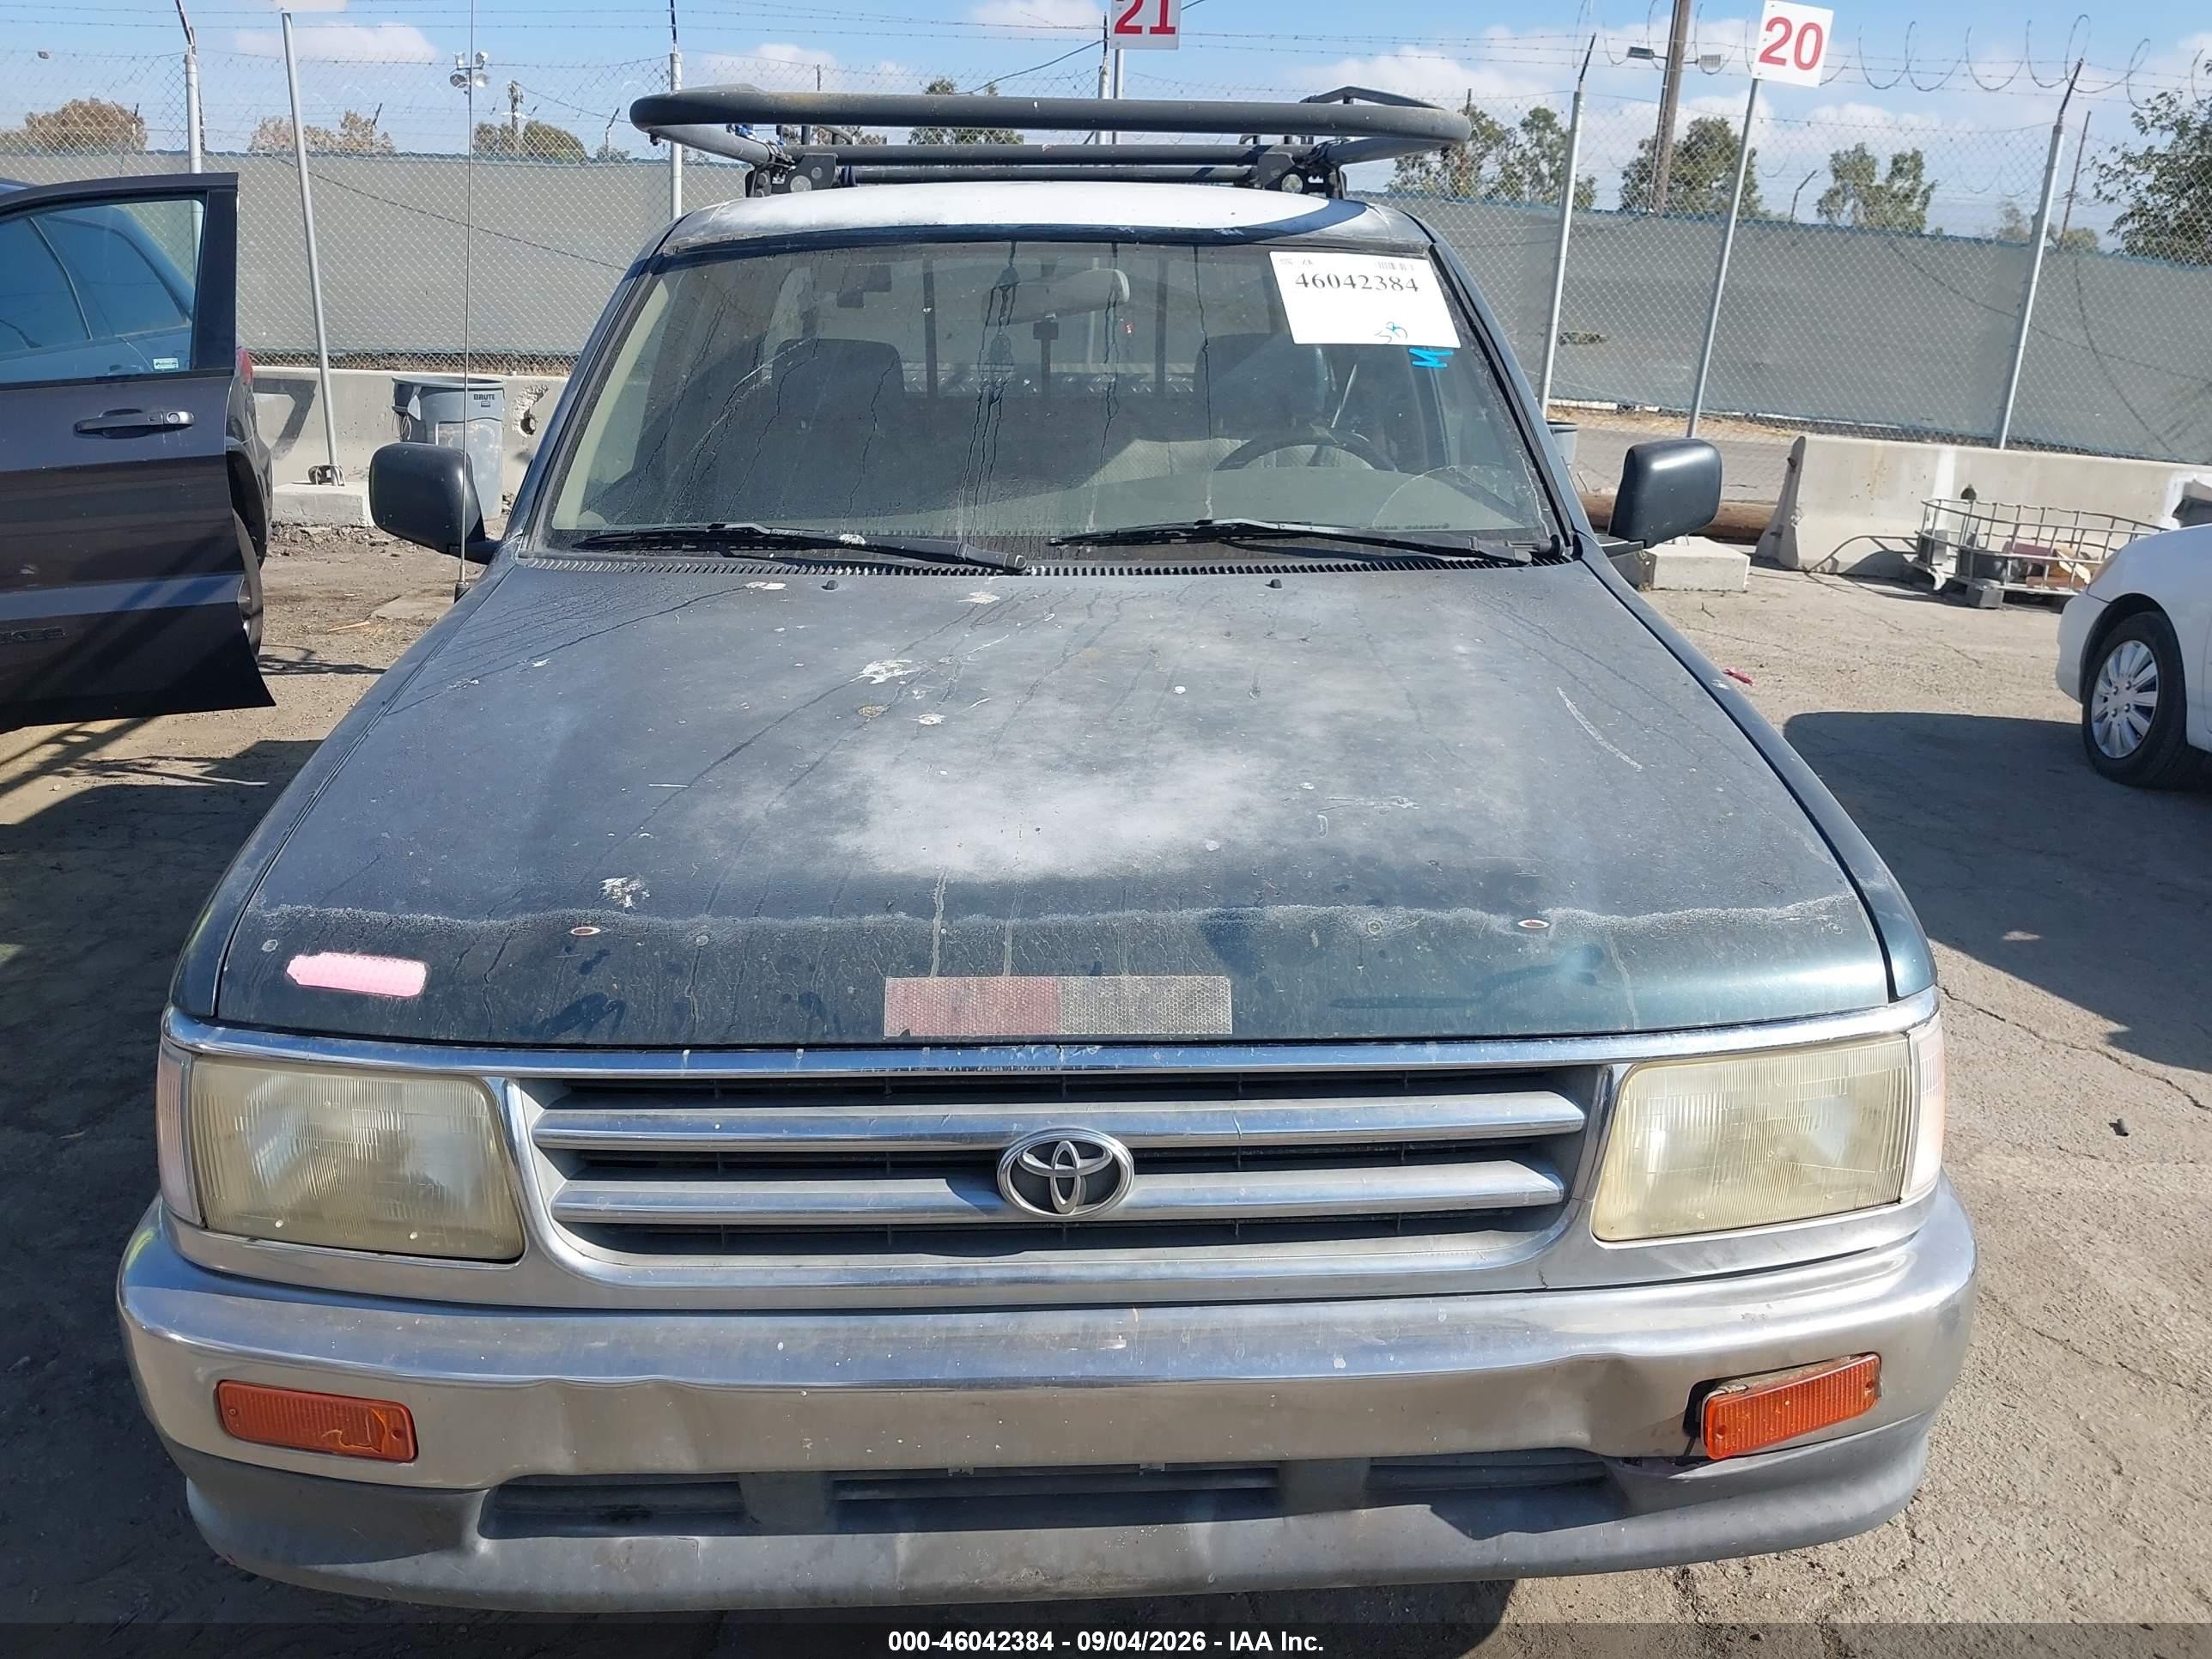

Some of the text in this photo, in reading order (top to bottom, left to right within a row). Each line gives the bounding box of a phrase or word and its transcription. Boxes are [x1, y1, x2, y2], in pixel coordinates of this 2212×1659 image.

[1114, 0, 1176, 34] 21
[1759, 16, 1823, 70] 20
[1294, 272, 1419, 293] 46042384
